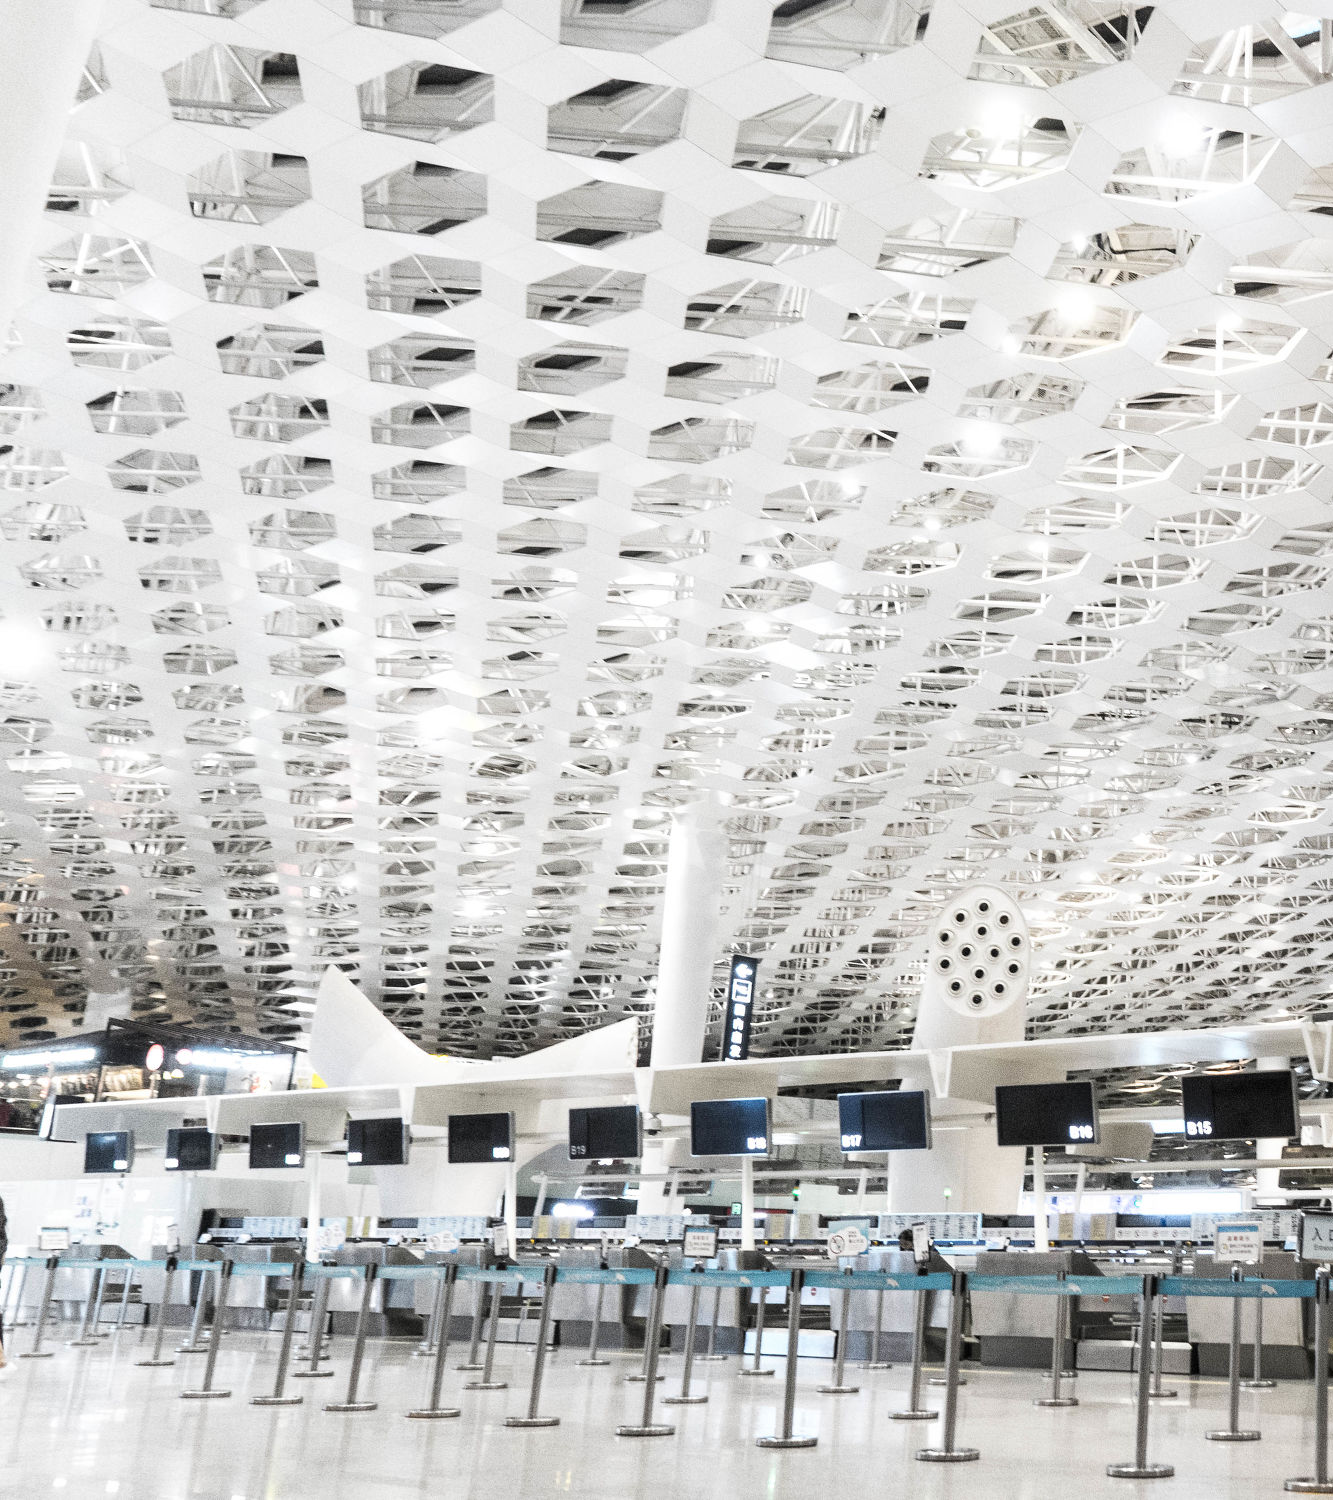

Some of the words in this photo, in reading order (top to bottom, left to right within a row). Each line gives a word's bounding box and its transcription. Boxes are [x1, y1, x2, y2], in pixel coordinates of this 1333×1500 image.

[1186, 1120, 1213, 1136] B15
[841, 1134, 862, 1147] B17
[570, 1145, 586, 1155] B19
